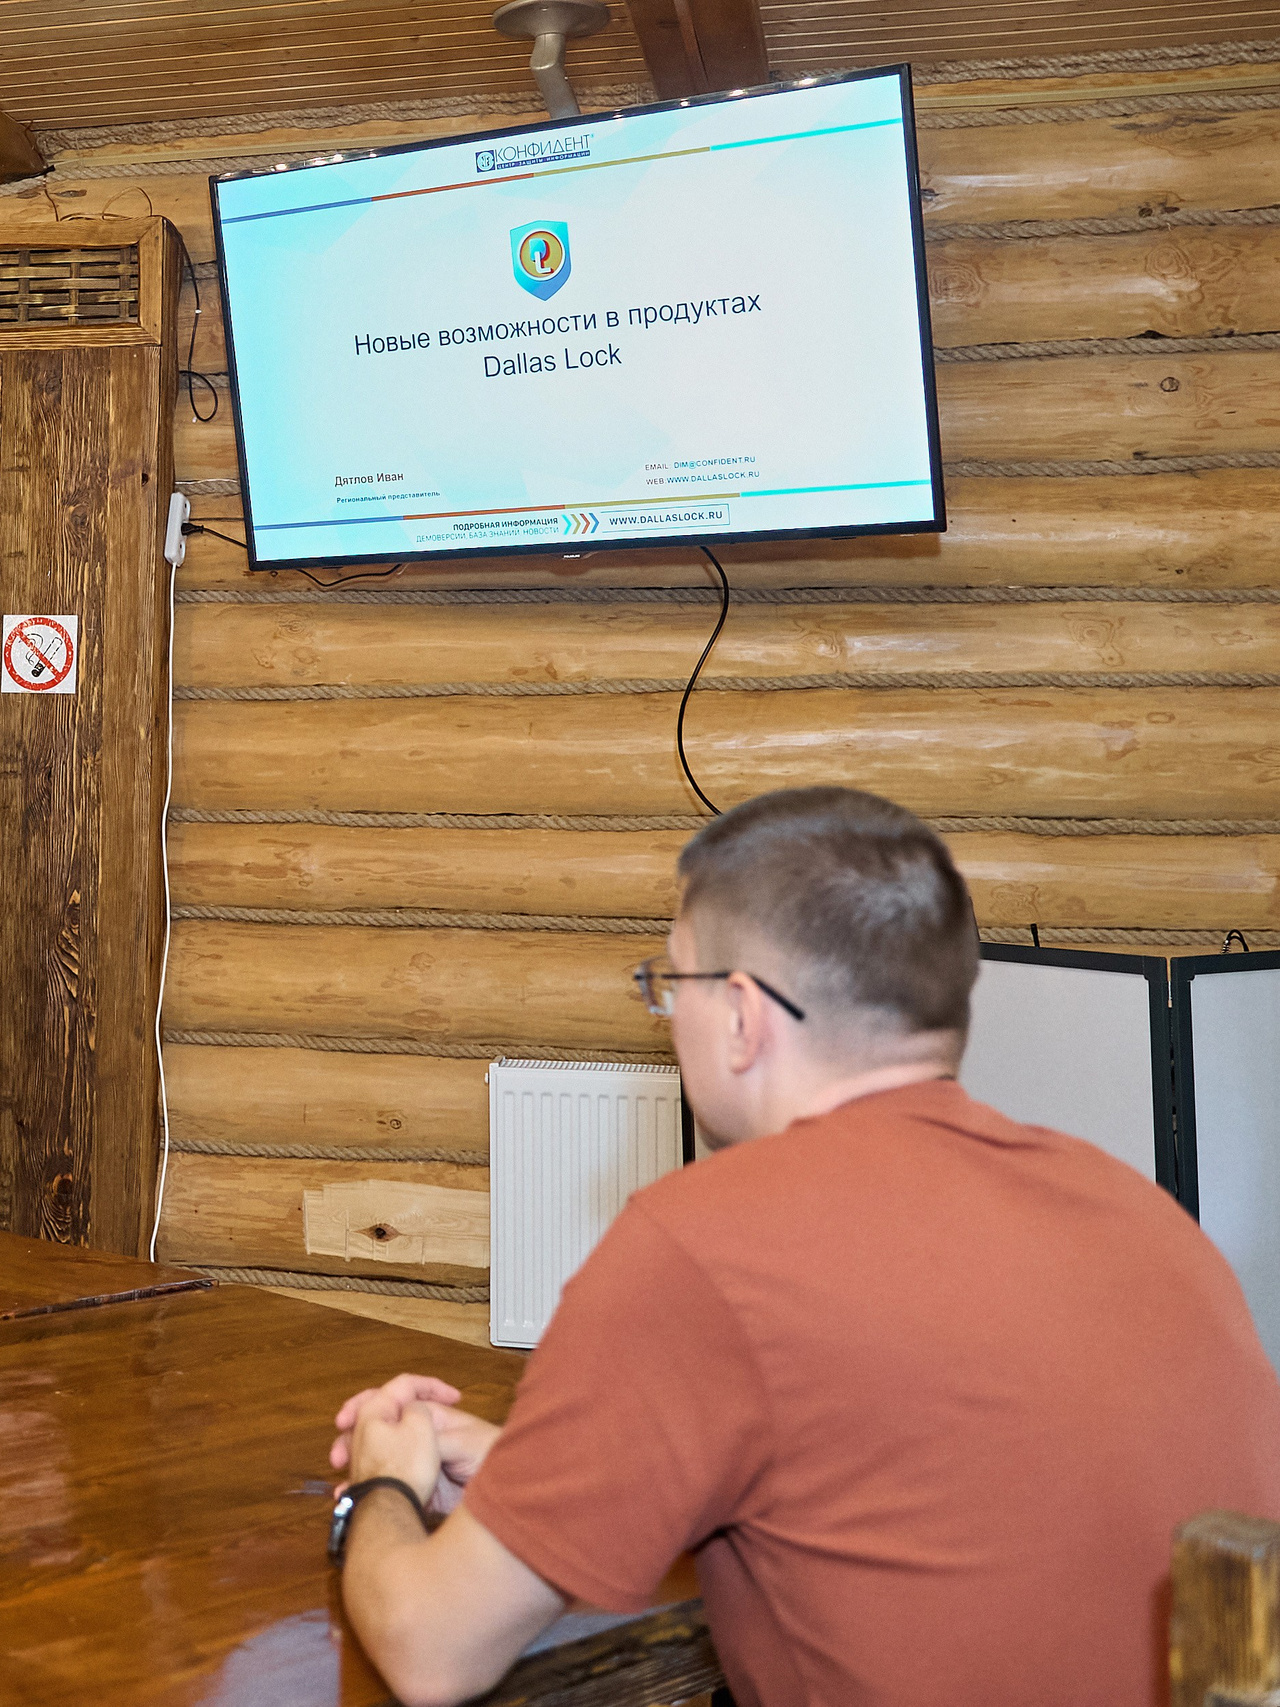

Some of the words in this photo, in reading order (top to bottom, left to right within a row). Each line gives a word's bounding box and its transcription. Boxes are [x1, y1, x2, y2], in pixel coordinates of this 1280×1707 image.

[494, 134, 590, 162] КОНФИДЕНТ
[354, 332, 431, 356] Новые
[438, 313, 598, 346] возможности
[606, 311, 620, 328] в
[628, 294, 762, 329] продуктах
[483, 352, 557, 378] Dallas
[564, 343, 622, 369] Lock
[334, 475, 374, 487] Дятлов
[376, 472, 404, 483] Иван
[336, 494, 387, 503] Региональный
[387, 490, 441, 500] представитель
[453, 521, 500, 531] ПОДРОБНАЯ
[501, 517, 558, 528] ИНФОРМАЦИЯ
[609, 511, 723, 525] WWW.DALLASLOCK.RU
[469, 531, 488, 539] БАЗА
[523, 527, 559, 536] НОВОСТИ
